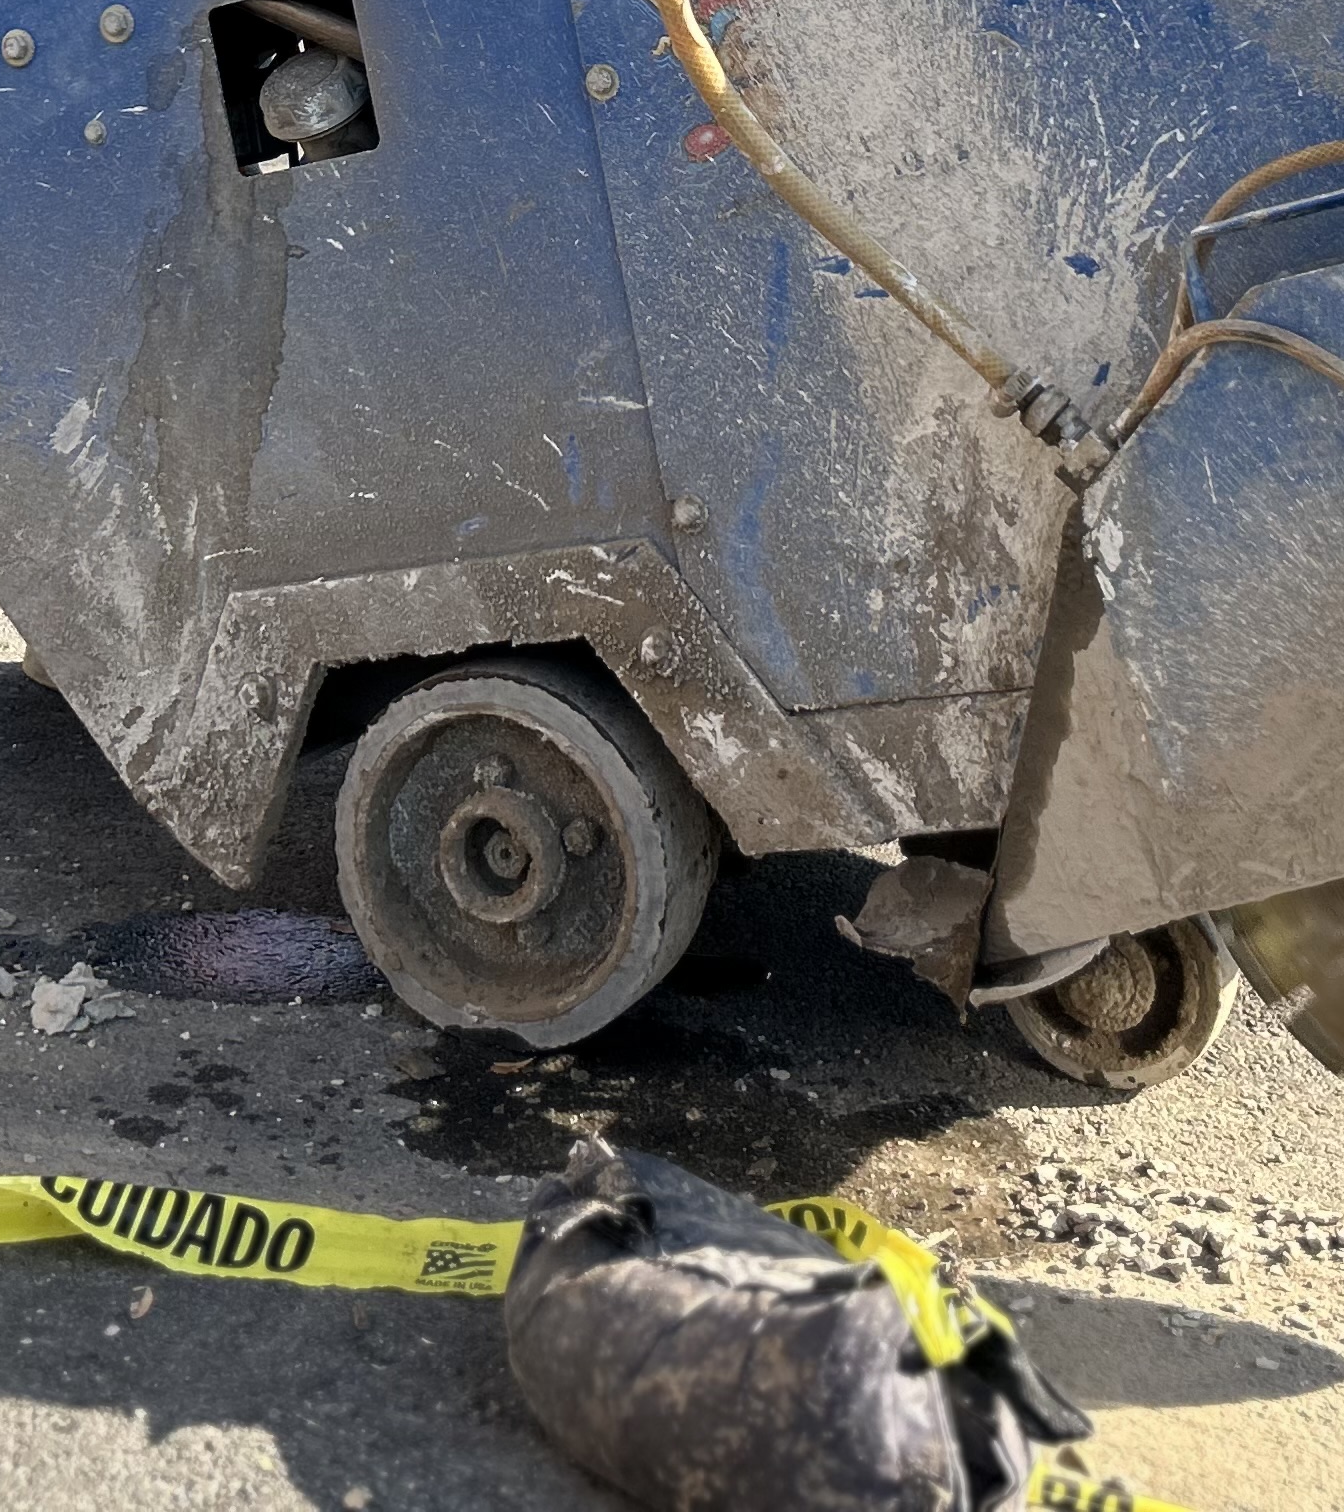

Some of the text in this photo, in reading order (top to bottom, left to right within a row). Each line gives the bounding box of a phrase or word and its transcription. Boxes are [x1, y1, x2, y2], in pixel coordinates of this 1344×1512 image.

[40, 1175, 316, 1273] CUIDADO
[415, 1278, 494, 1291] MADE IN USA
